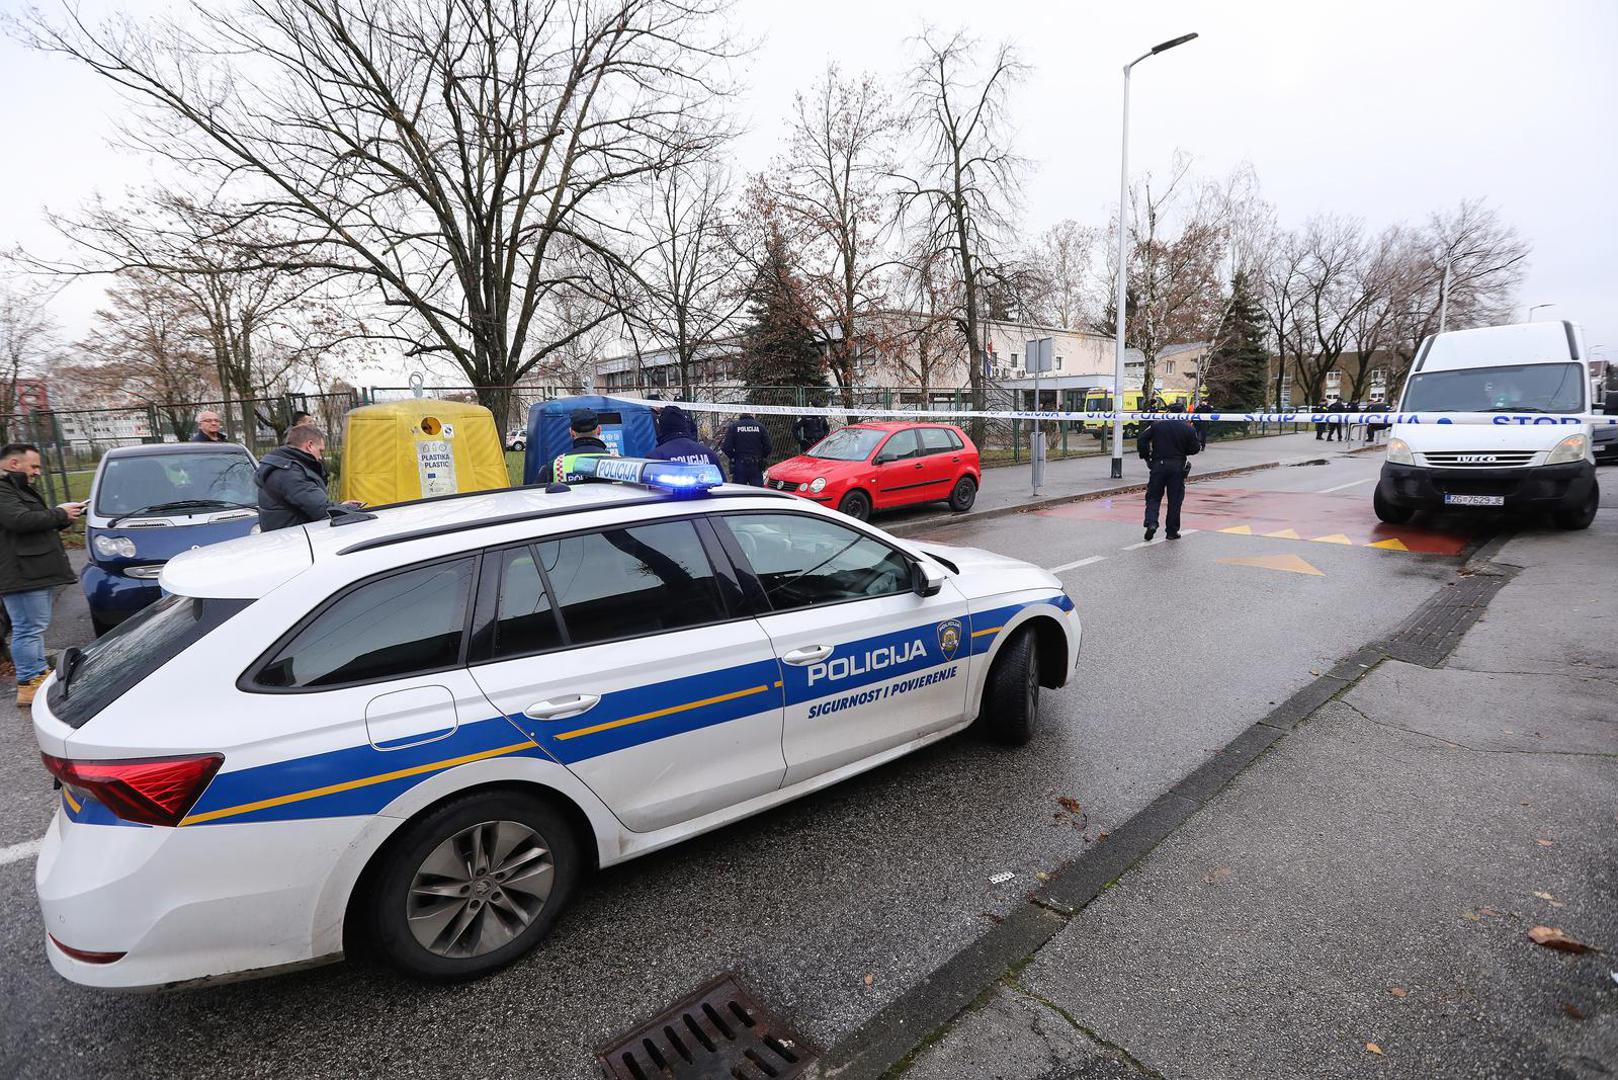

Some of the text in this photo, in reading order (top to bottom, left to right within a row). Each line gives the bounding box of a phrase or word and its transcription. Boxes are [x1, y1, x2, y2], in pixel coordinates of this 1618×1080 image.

[670, 454, 710, 466] POLICIJA
[1457, 455, 1496, 463] IVECO
[598, 460, 637, 481] POLICIJA
[939, 621, 960, 632] POLICIJA
[808, 639, 928, 687] POLICIJA
[808, 666, 958, 719] SIGURNOST I POVJERENJE
